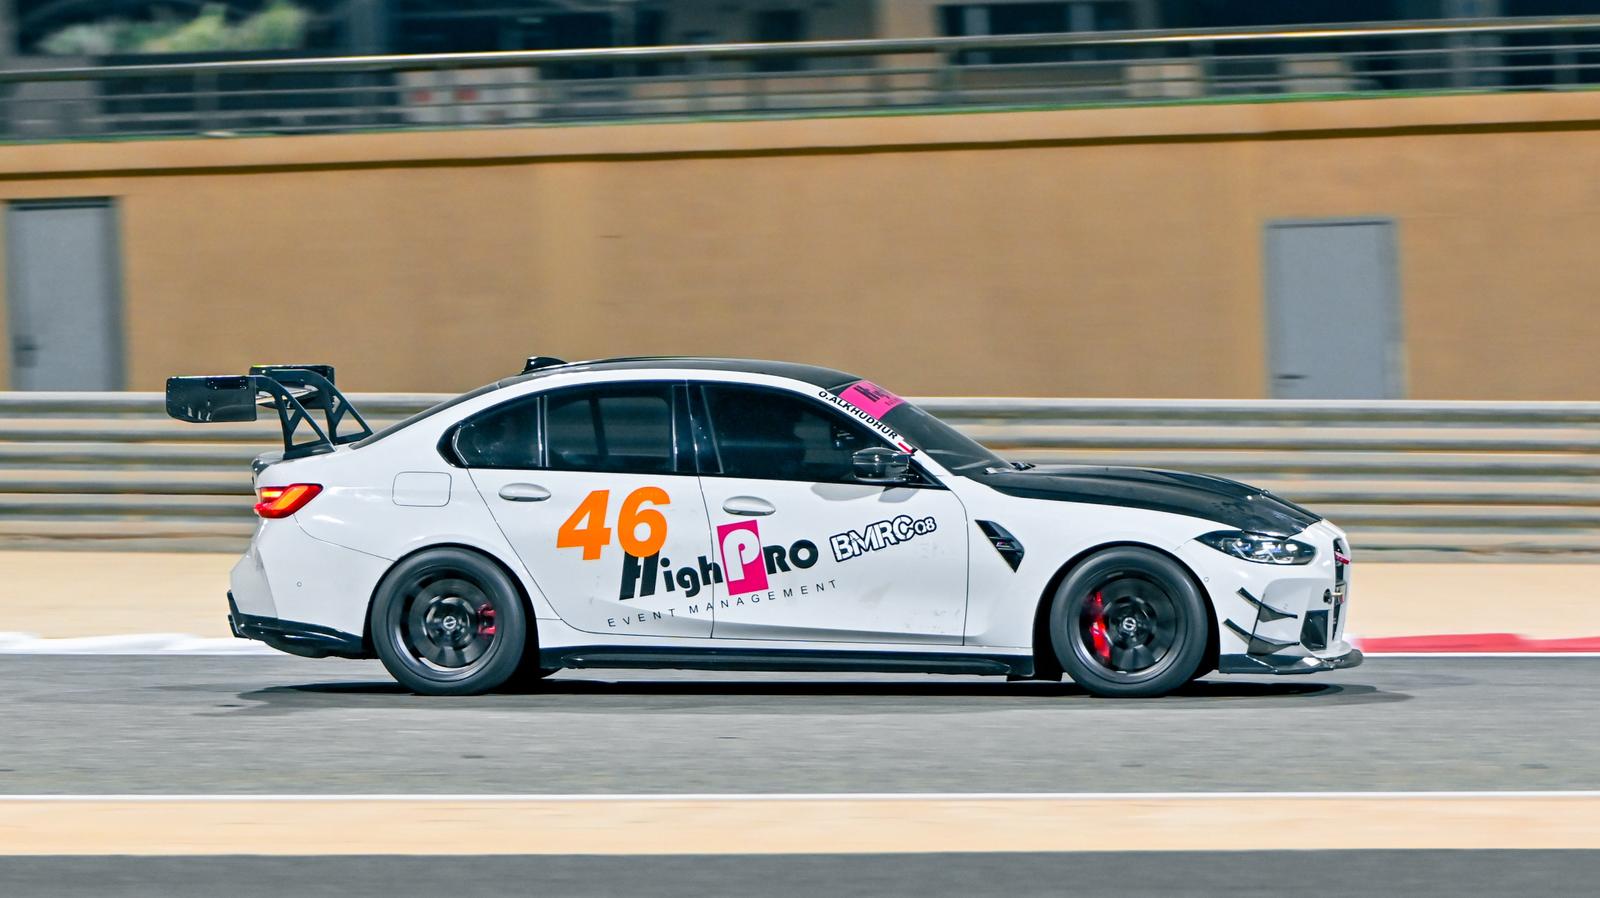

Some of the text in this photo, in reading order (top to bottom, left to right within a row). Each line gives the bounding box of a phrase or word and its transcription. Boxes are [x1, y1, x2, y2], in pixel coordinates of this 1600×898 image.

[818, 391, 898, 440] O.ALKHUDHUR
[556, 486, 671, 560] 46
[607, 579, 837, 628] EVENT MANAGEMENT
